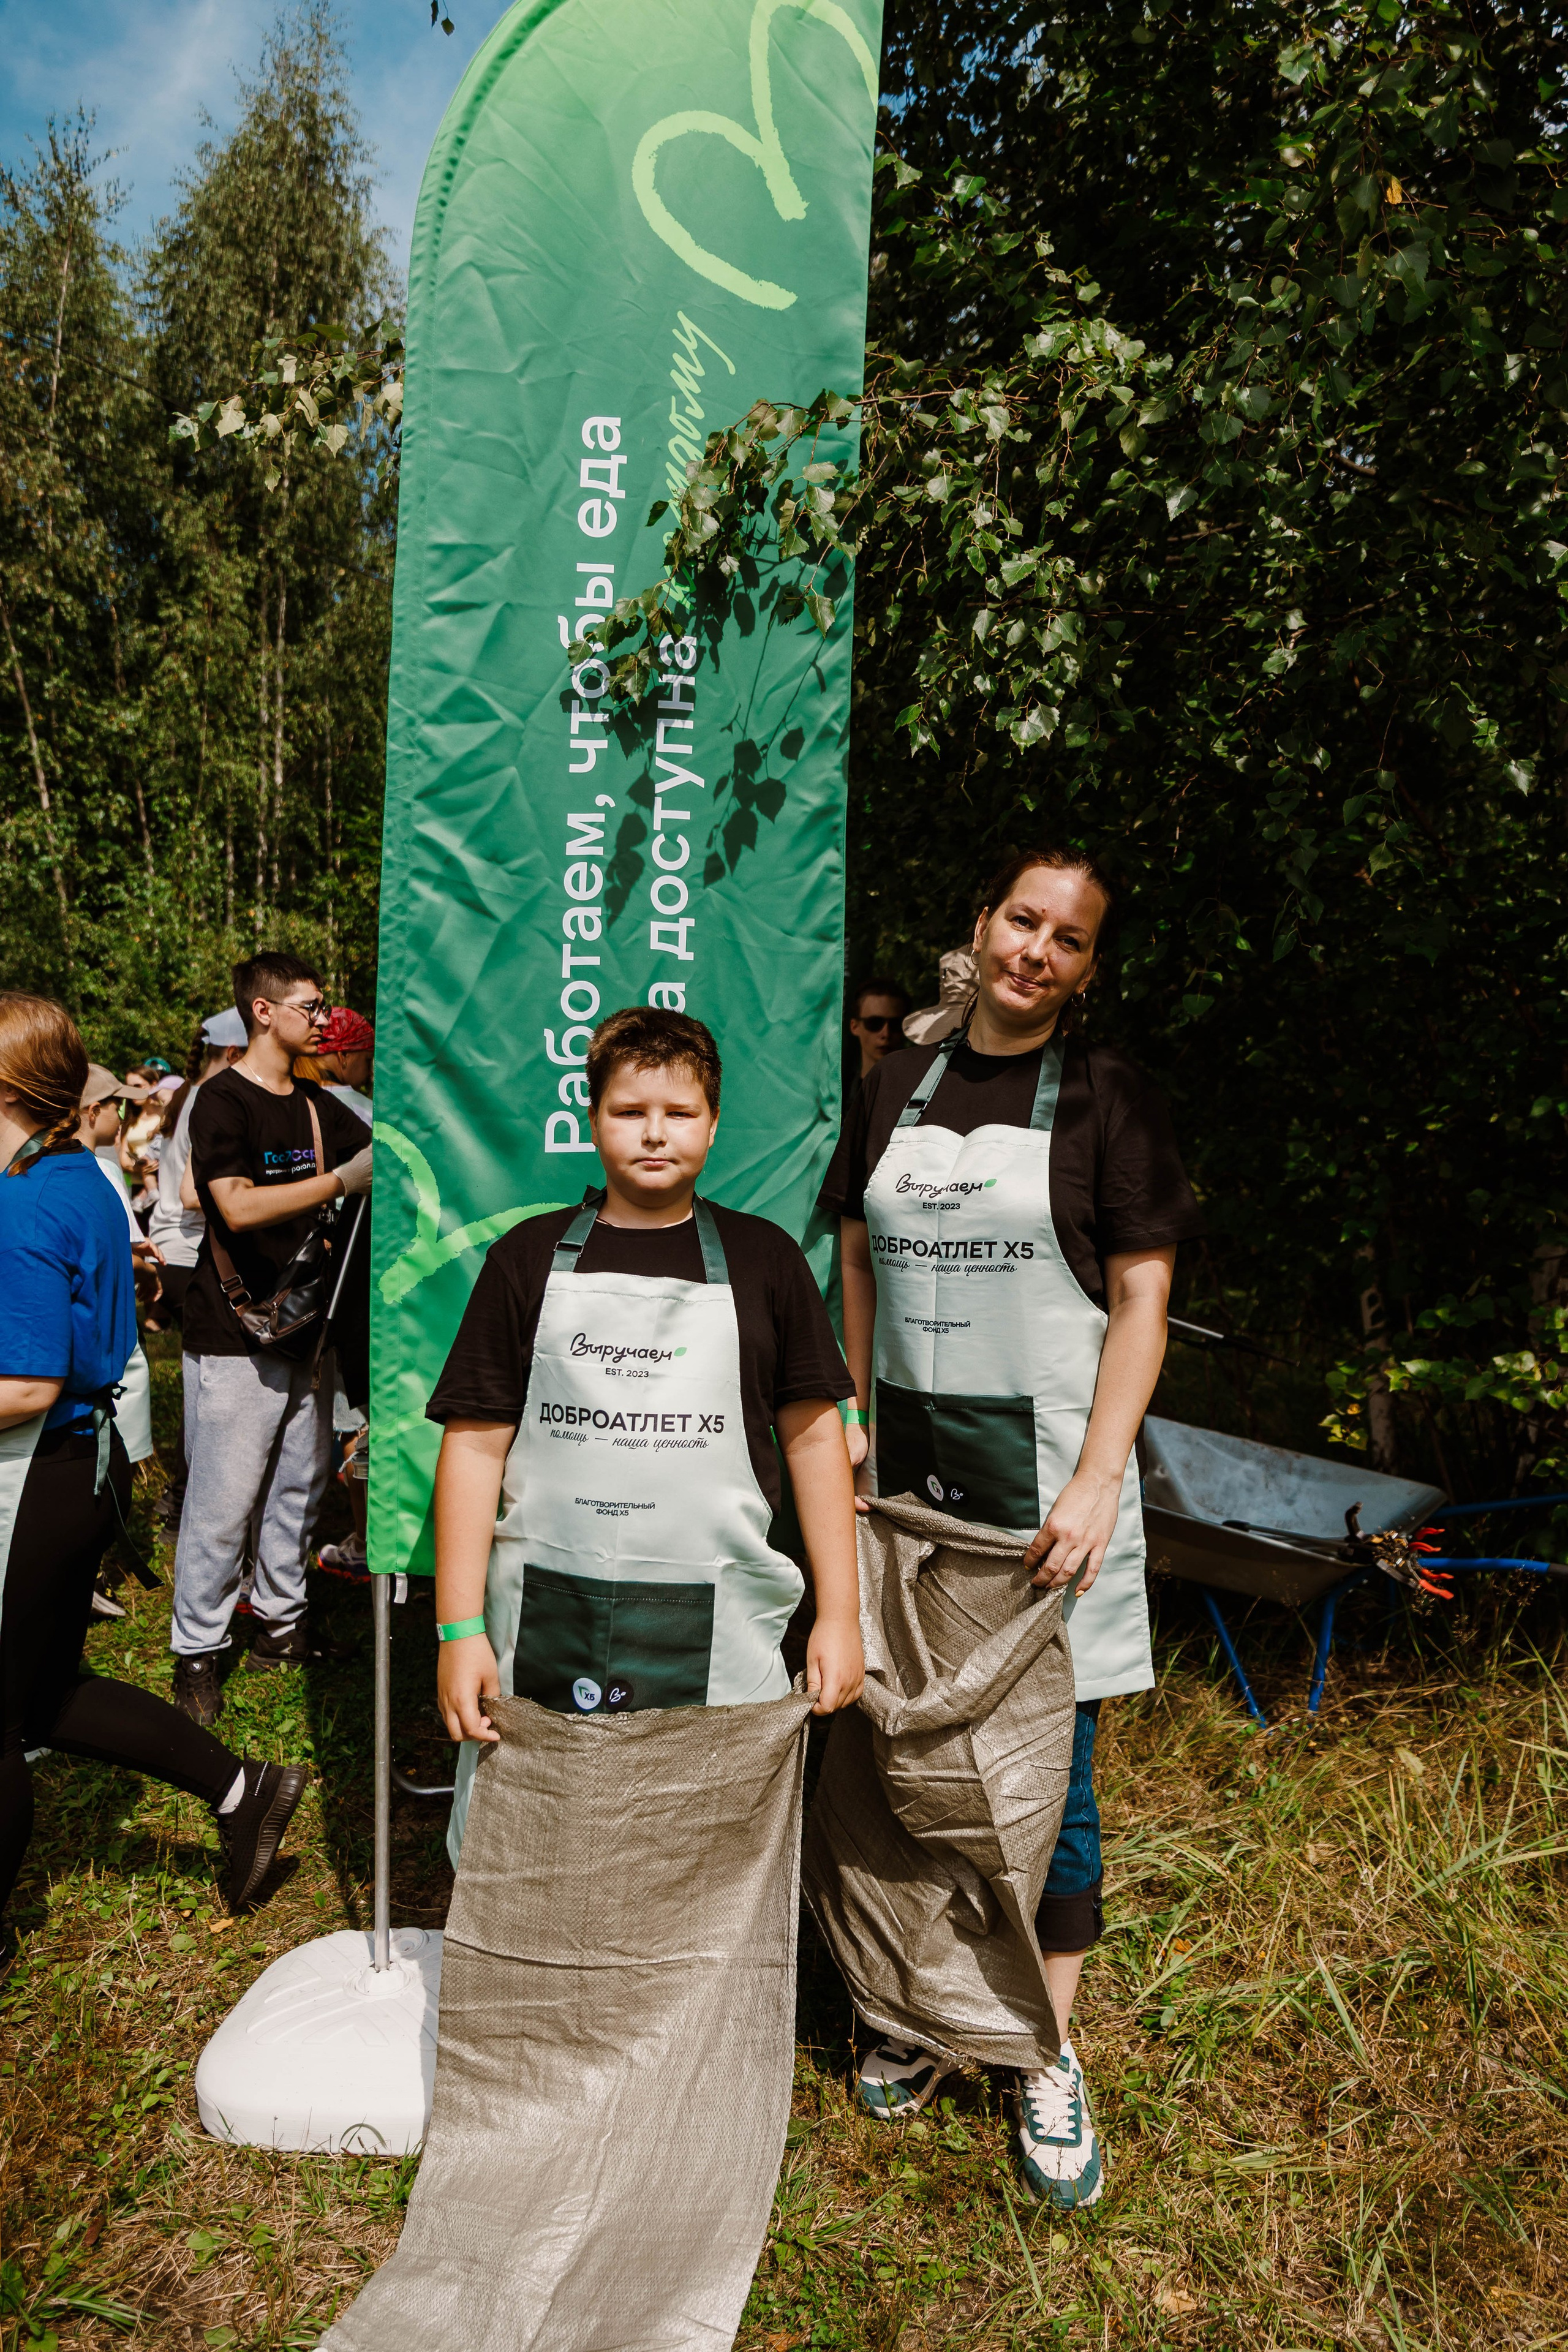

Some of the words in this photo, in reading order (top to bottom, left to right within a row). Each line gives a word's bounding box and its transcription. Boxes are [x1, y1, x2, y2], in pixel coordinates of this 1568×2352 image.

[578, 417, 628, 538] еда
[558, 562, 615, 773] чтобы
[650, 633, 705, 961] доступна
[544, 794, 616, 1153] Работаем,
[872, 1235, 997, 1259] ДОБРОАТЛЕТ
[879, 1257, 910, 1272] помощь
[931, 1263, 961, 1275] наша
[964, 1262, 1017, 1276] ценность
[905, 1317, 971, 1327] БЛАГОТВОРИТЕЛЬНЫЙ
[570, 1332, 673, 1363] Выручаем
[605, 1368, 624, 1376] EST.
[540, 1403, 692, 1432] ДОБРОАТЛЕТ
[550, 1429, 589, 1446] помощь
[612, 1438, 649, 1449] наша
[654, 1437, 710, 1452] ценность
[575, 1498, 655, 1509] БЛАГОТВОРИТЕЛЬНЫЙ
